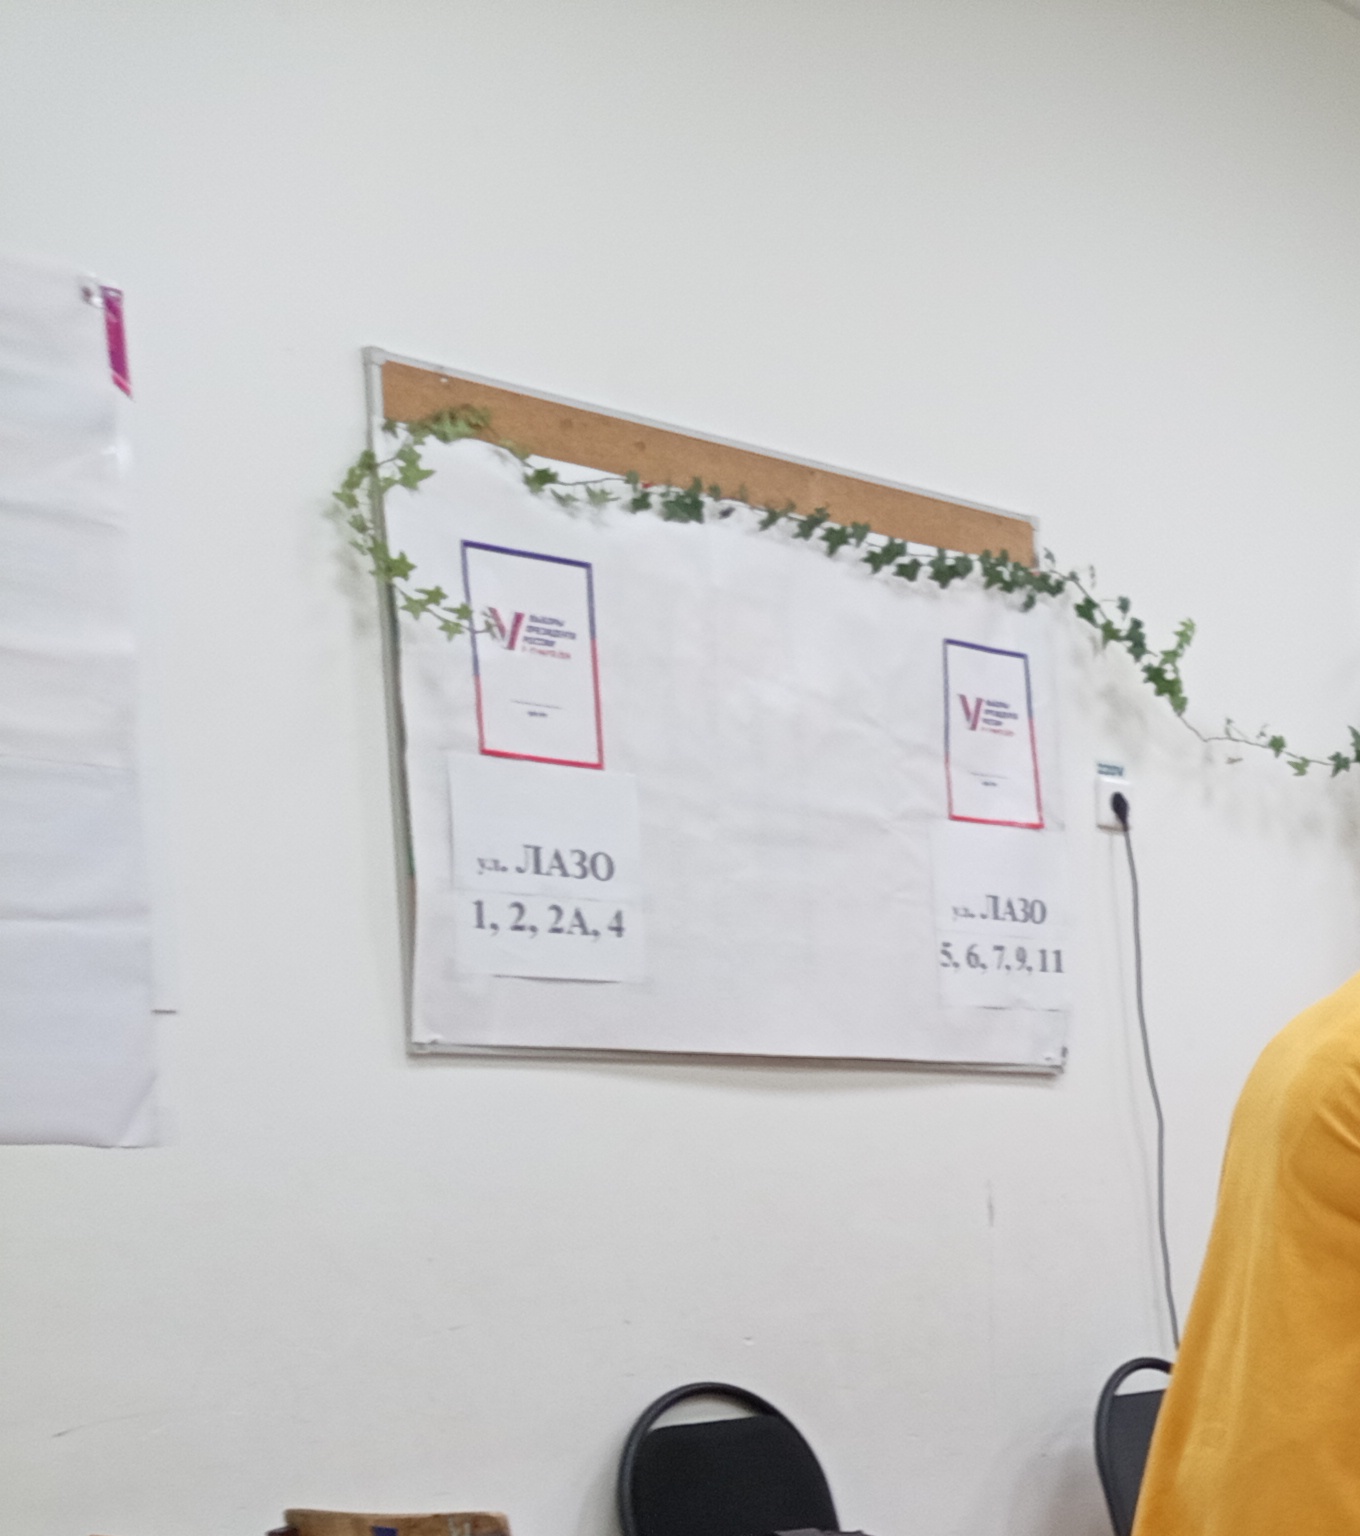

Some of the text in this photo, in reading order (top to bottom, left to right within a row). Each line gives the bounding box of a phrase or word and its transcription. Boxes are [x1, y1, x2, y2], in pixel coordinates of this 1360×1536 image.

[515, 844, 615, 881] ЛАЗО
[607, 909, 625, 938] 4
[980, 894, 1047, 925] ЛАЗО
[1038, 948, 1065, 974] 11
